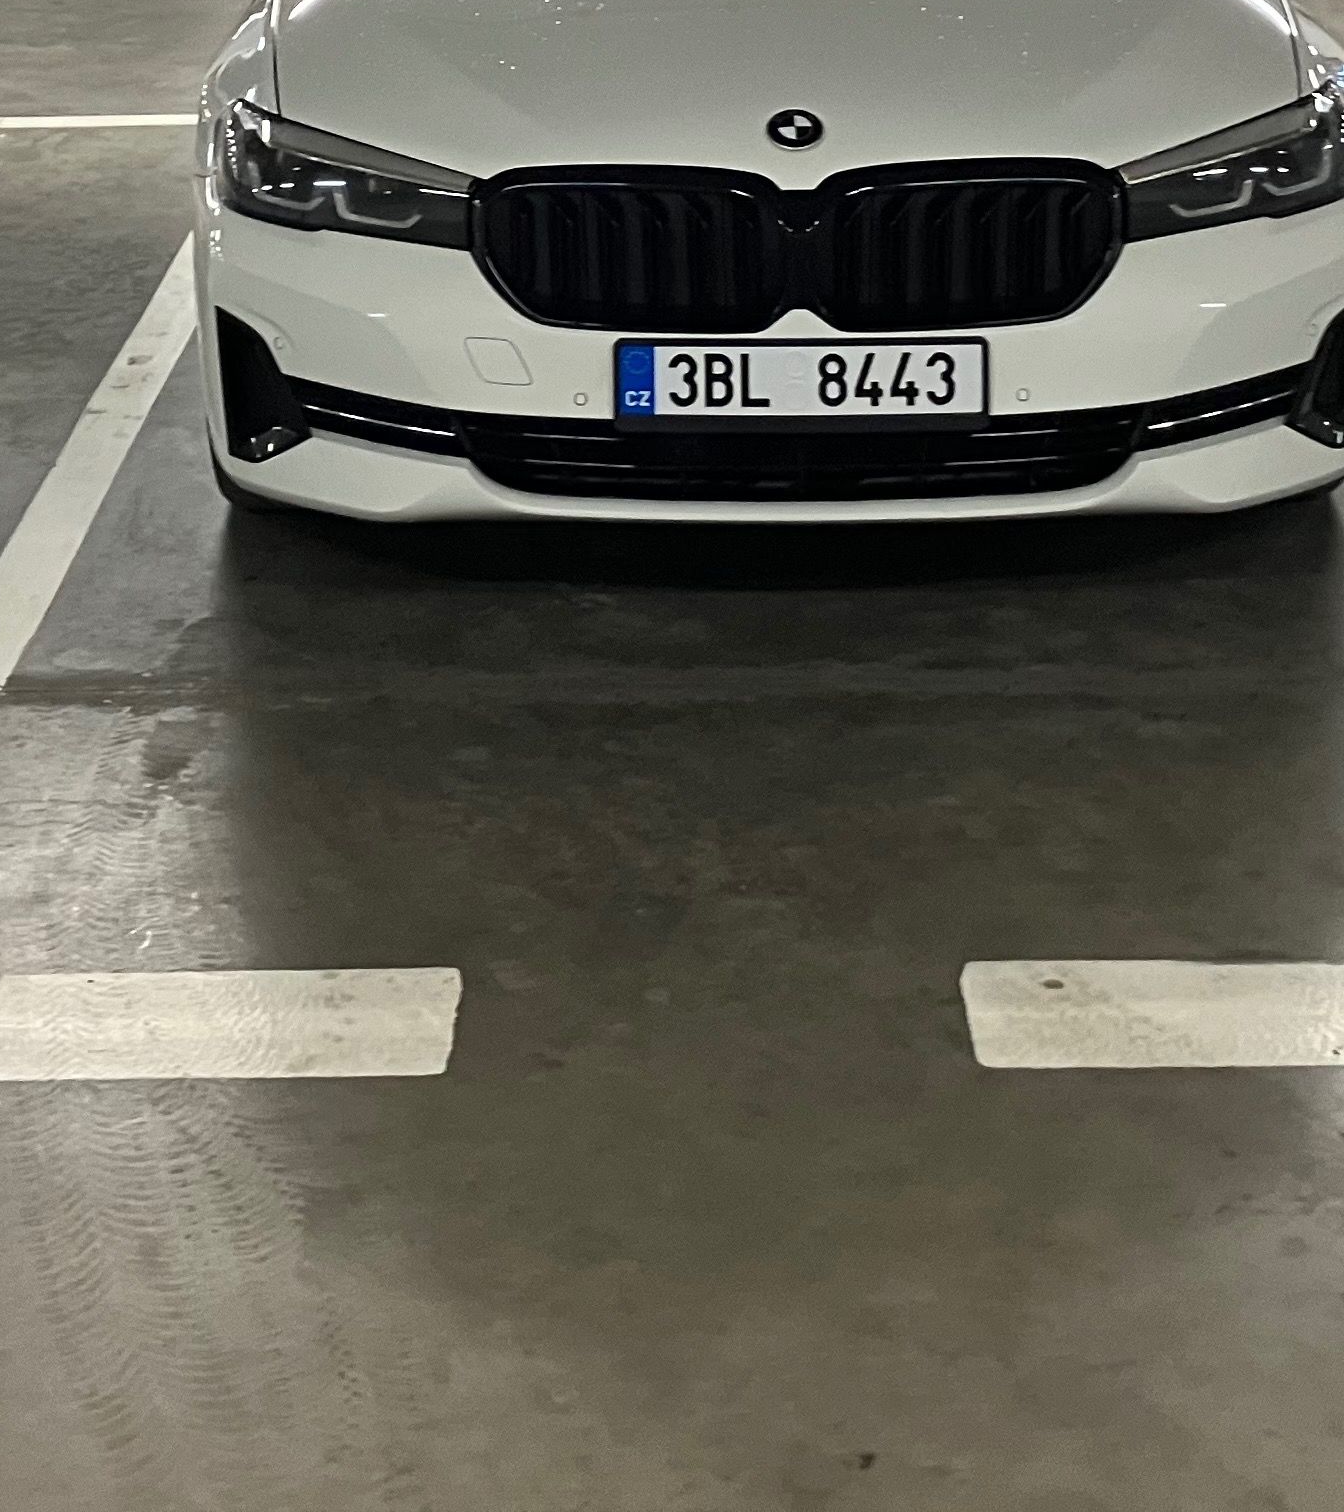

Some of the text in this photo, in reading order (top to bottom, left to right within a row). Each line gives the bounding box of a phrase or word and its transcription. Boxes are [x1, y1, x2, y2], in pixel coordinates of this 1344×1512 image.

[668, 351, 956, 408] 3BL 8443
[625, 390, 651, 407] CZ
